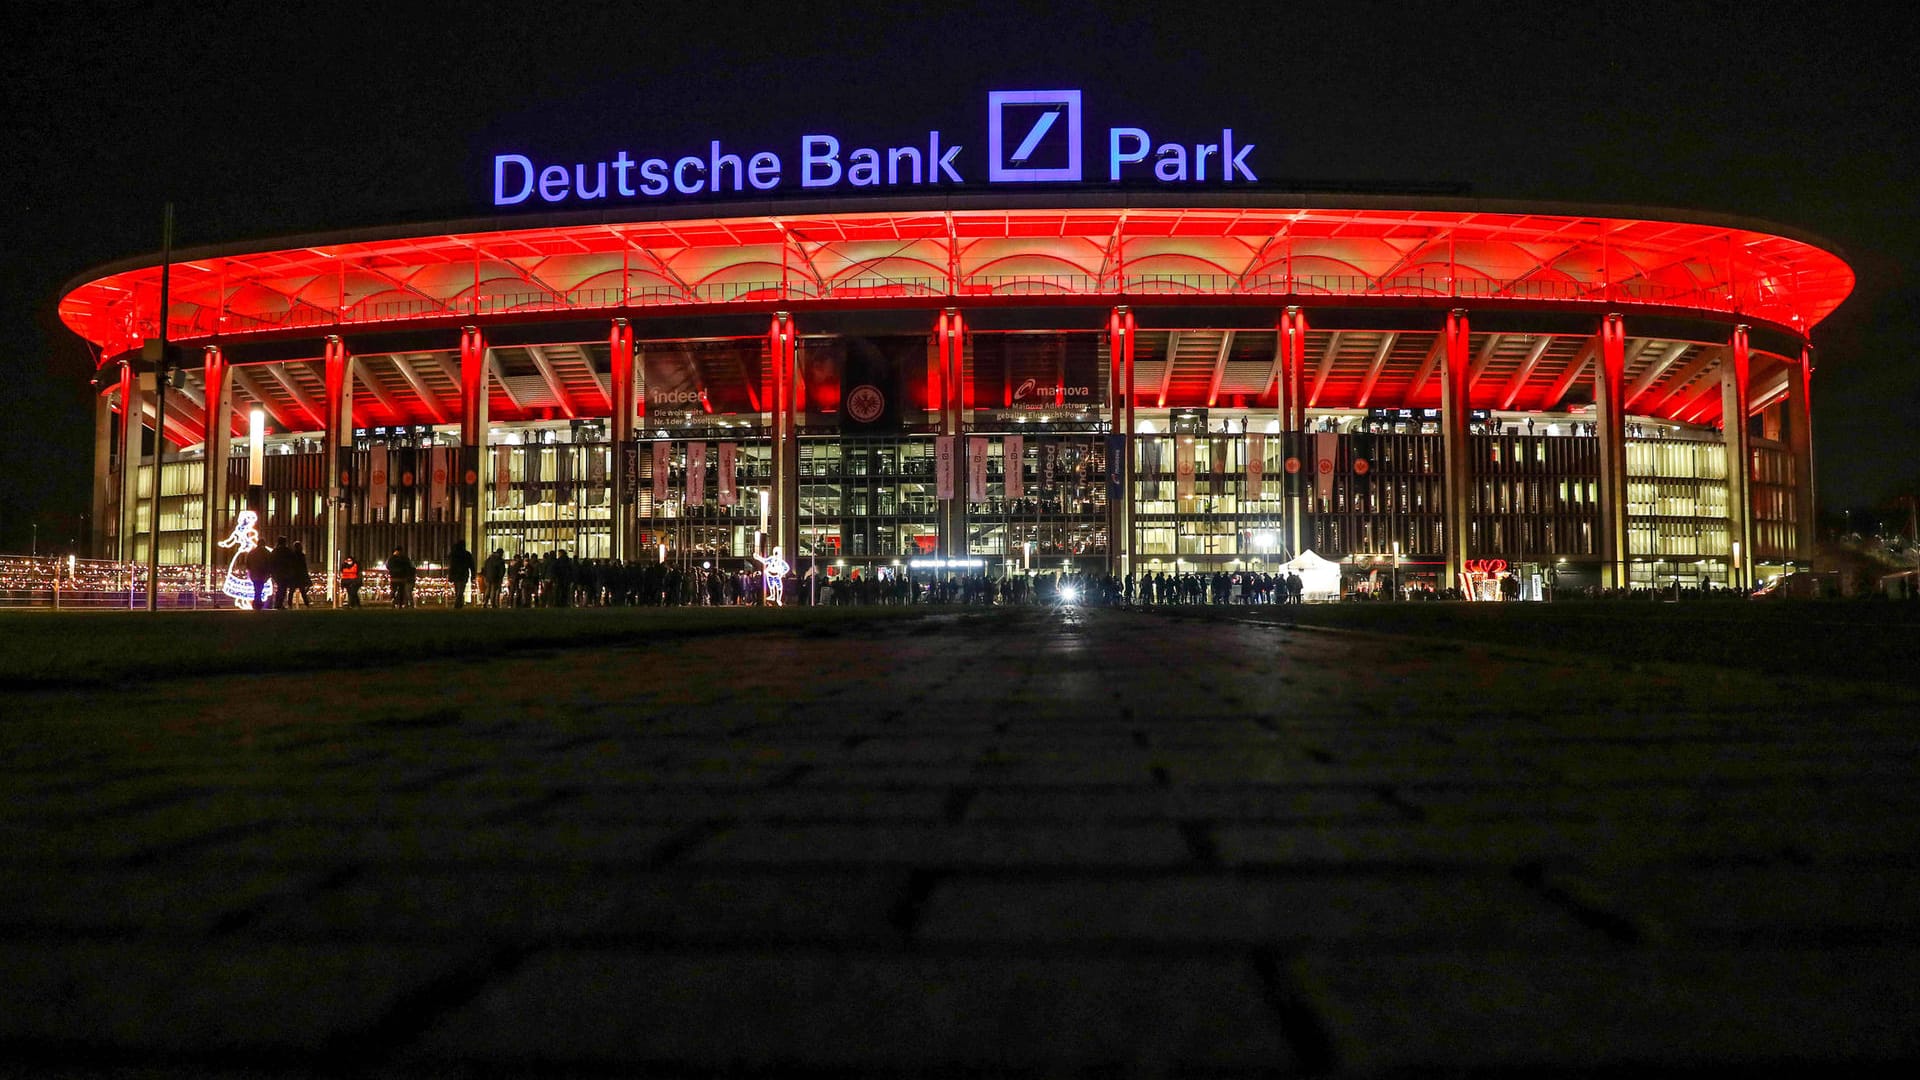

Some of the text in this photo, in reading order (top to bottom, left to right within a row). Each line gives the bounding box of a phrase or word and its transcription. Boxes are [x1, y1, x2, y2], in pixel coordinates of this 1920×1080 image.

[494, 127, 1258, 205] Deutsche Bank Park
[653, 387, 708, 403] indeed
[1036, 384, 1089, 396] mainova
[654, 409, 667, 417] Die
[625, 450, 636, 495] indeed
[1044, 445, 1055, 491] indeed
[1077, 444, 1088, 490] indeed
